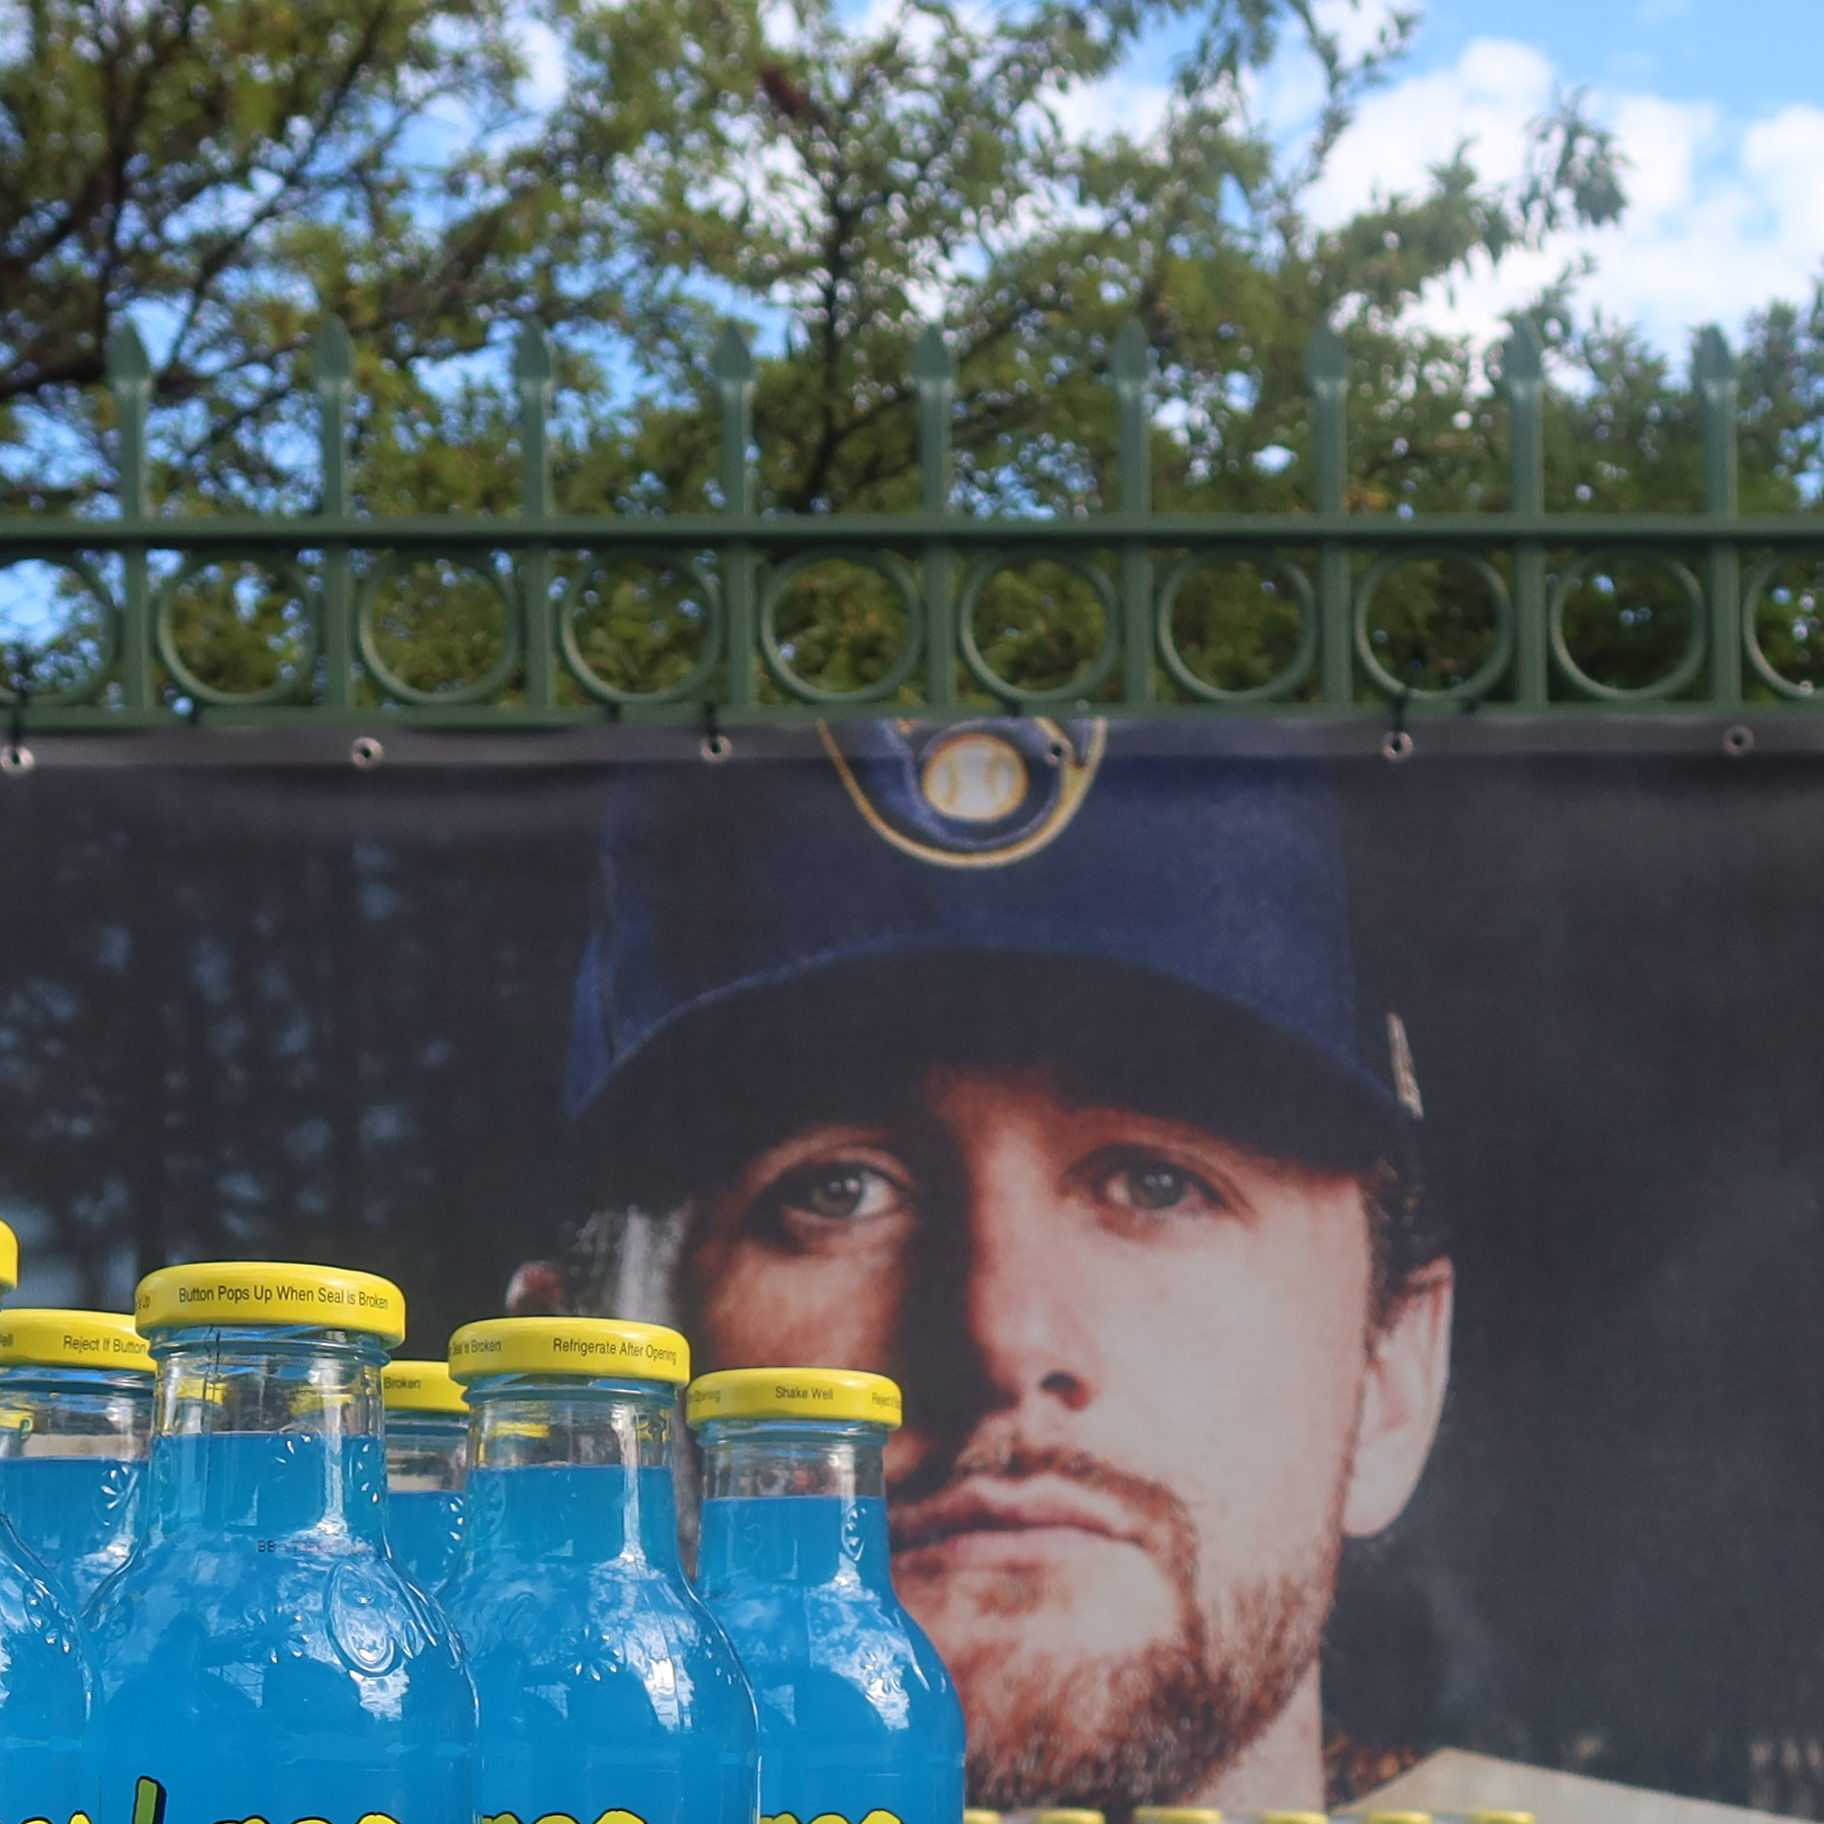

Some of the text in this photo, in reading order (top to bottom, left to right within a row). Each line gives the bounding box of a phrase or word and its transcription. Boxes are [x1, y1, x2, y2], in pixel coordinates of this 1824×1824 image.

[178, 1287, 214, 1304] Button
[217, 1285, 250, 1304] Pops
[254, 1285, 273, 1305] Up
[276, 1286, 314, 1301] When
[318, 1287, 344, 1304] Seal
[359, 1291, 389, 1310] Broken
[63, 1335, 100, 1353] Reject
[113, 1338, 147, 1354] Button
[552, 1336, 677, 1366] Refrigerate After Opening
[383, 1377, 422, 1389] Broken
[775, 1386, 834, 1400] Shake Well
